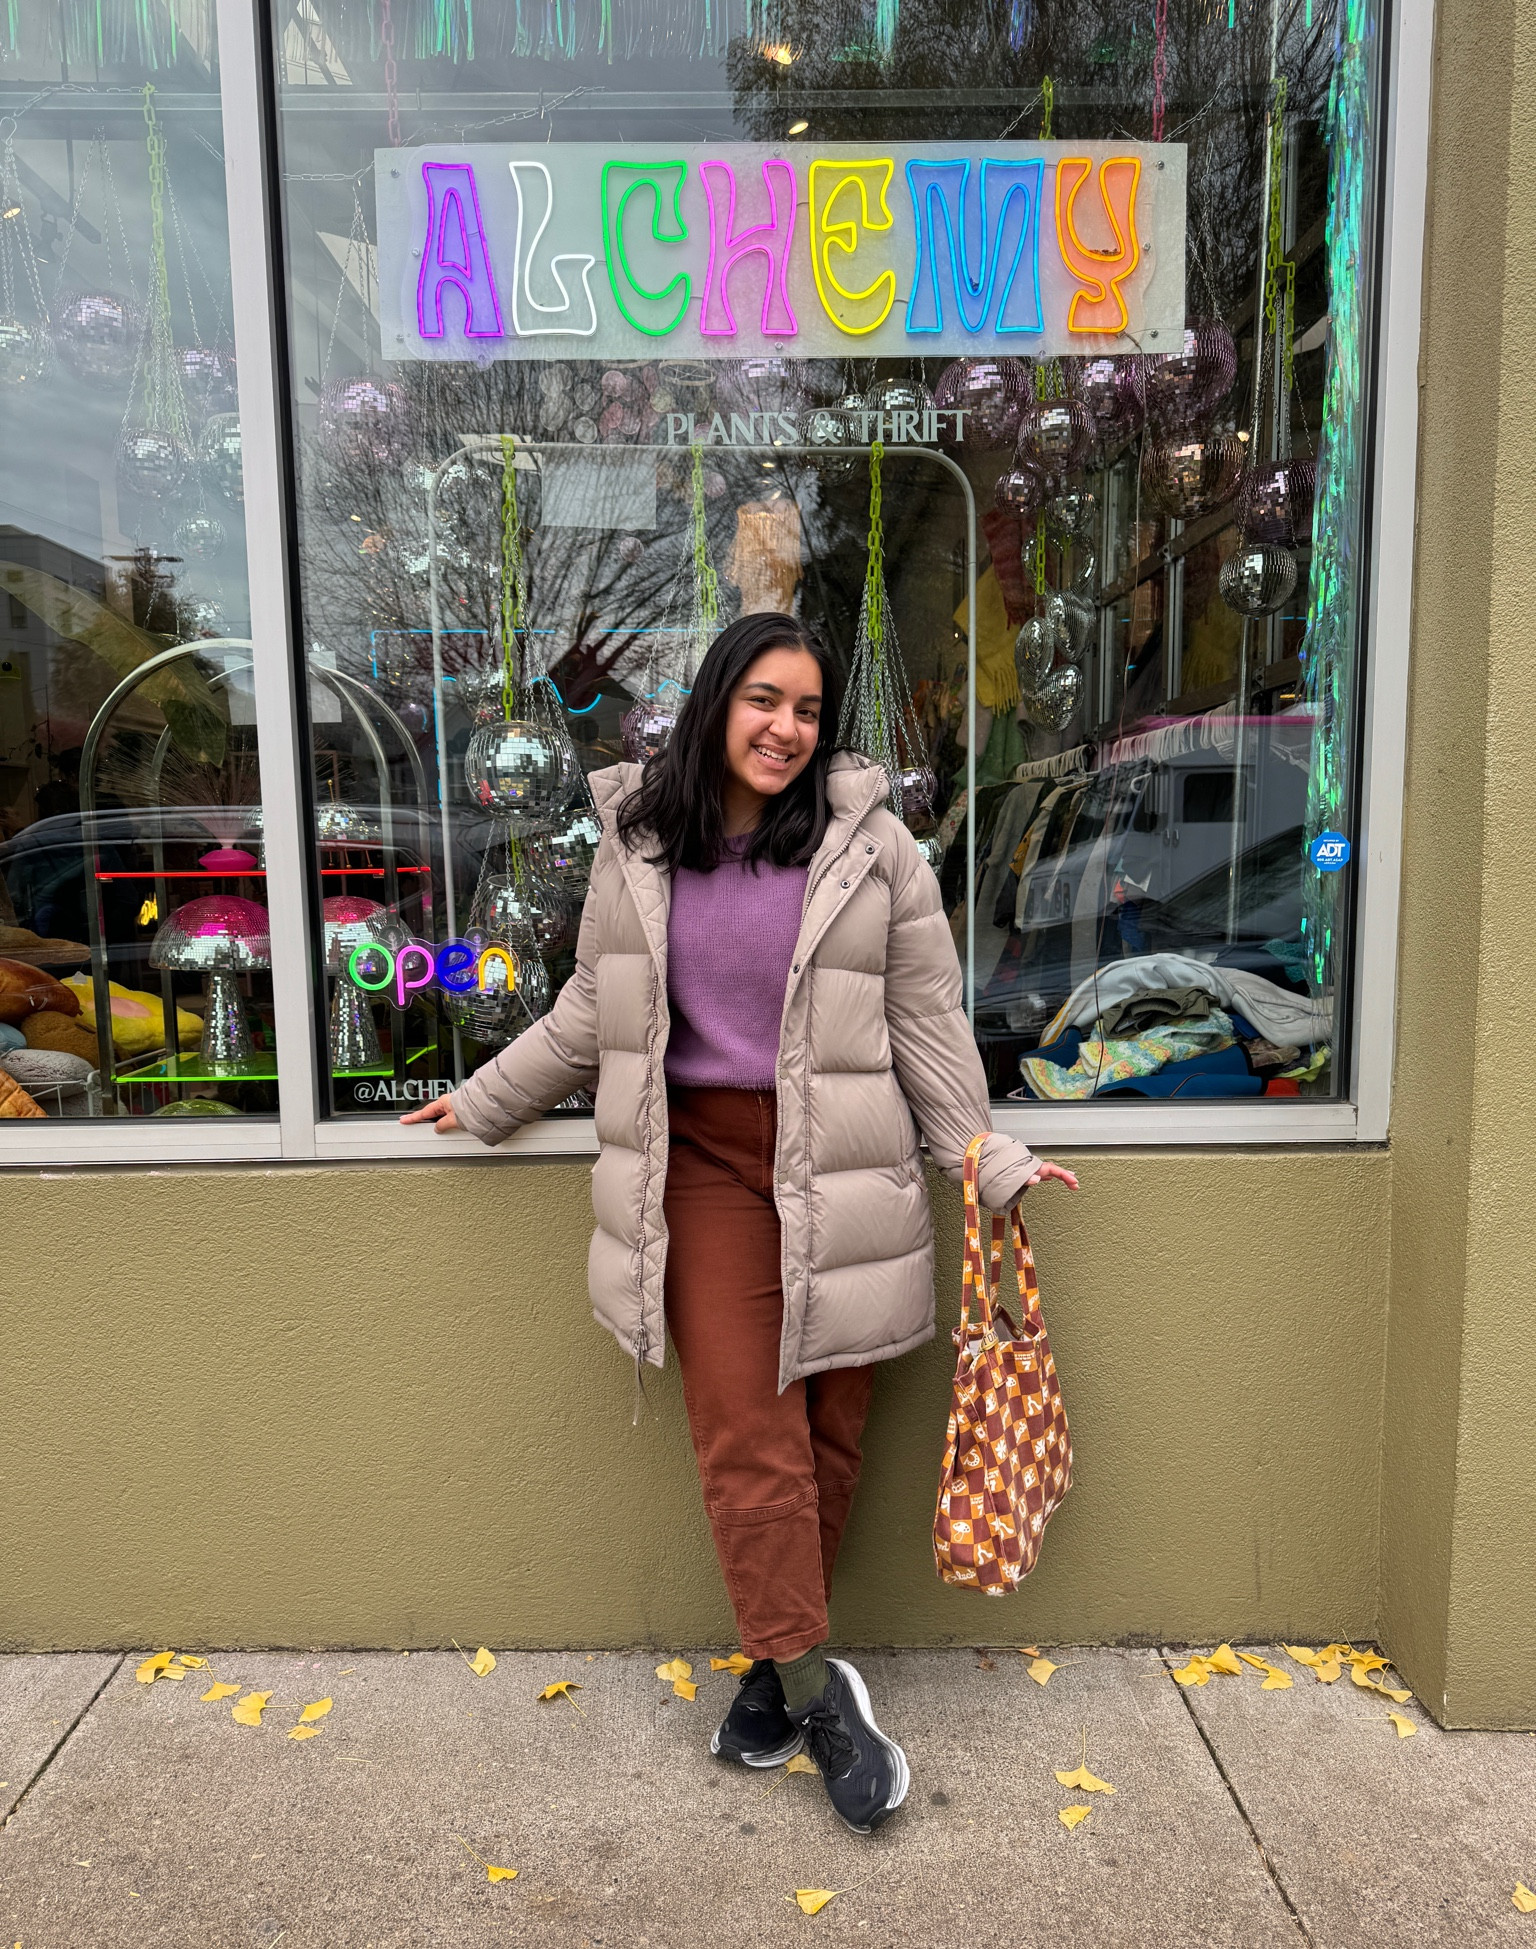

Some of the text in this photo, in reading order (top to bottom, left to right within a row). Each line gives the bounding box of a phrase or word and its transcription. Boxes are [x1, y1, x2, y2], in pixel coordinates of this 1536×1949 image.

[417, 157, 1141, 338] ALCHEMY
[666, 409, 973, 446] PLANTS & THRIFT
[1316, 843, 1346, 858] ADT
[349, 943, 515, 1006] open
